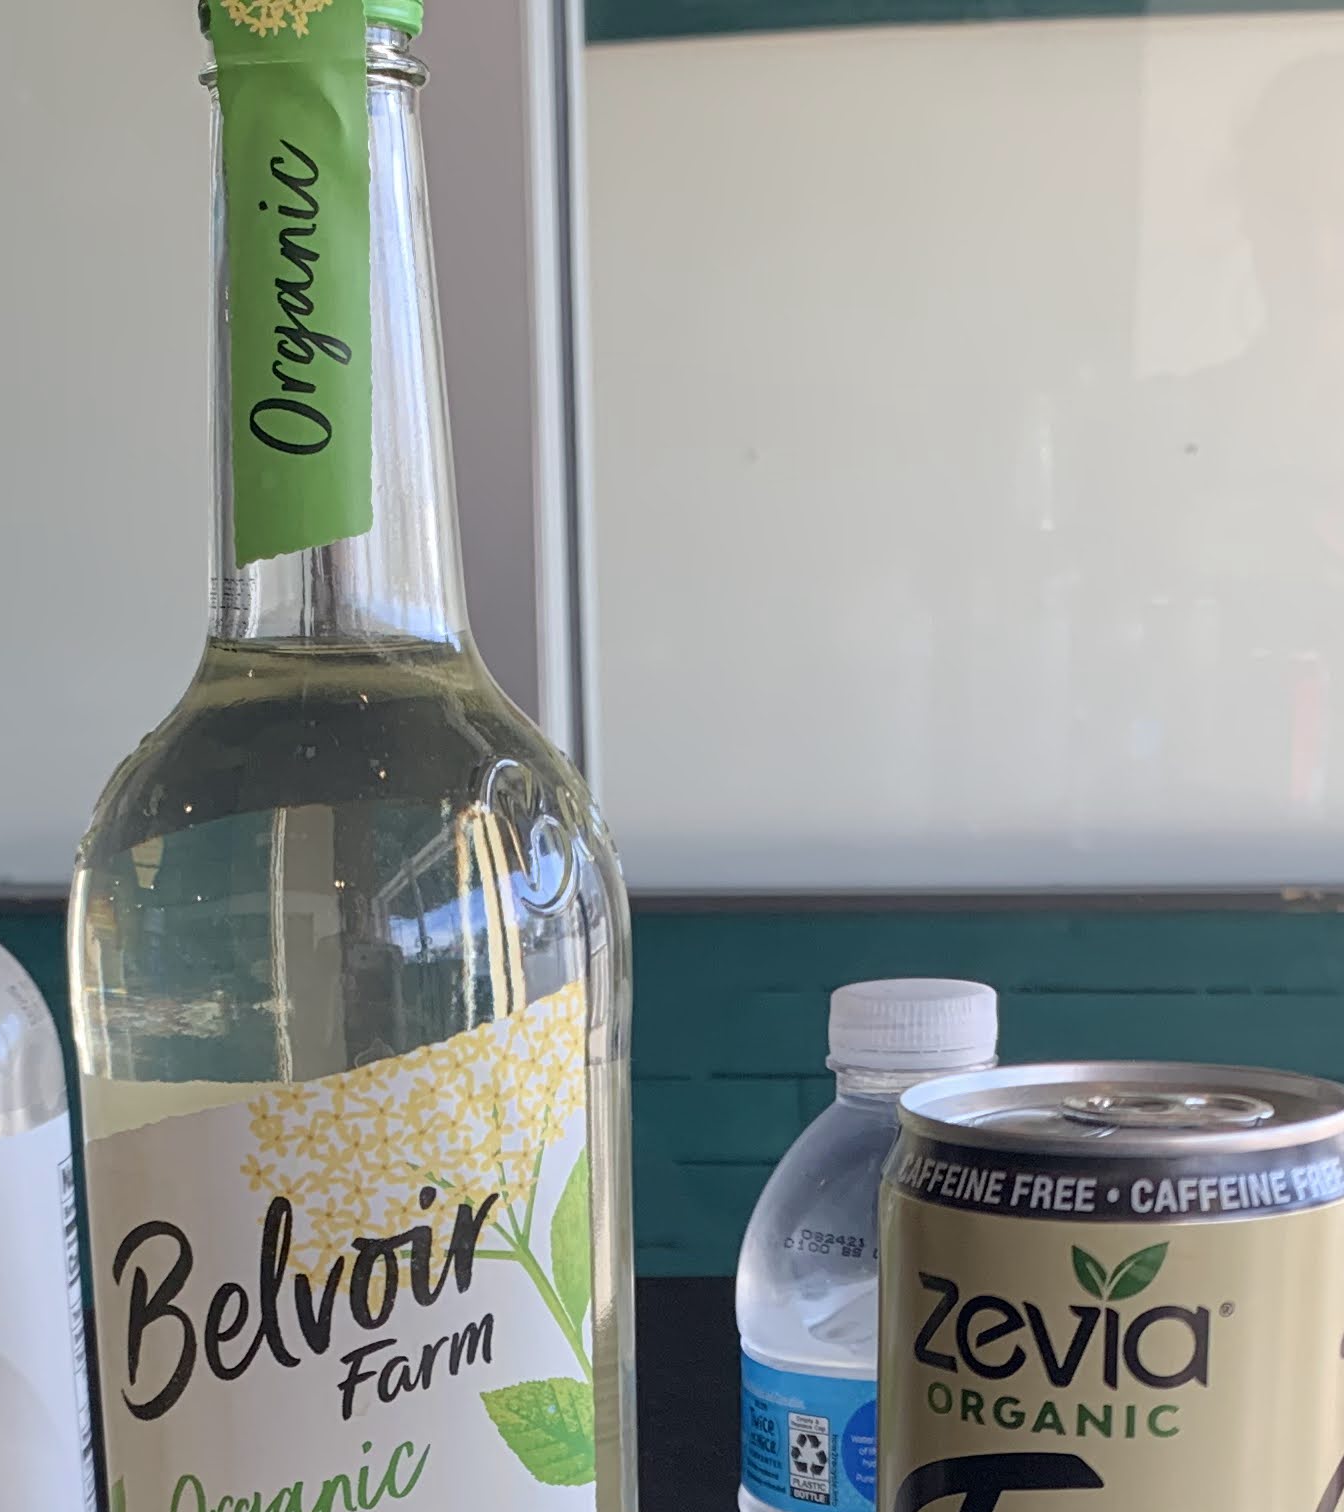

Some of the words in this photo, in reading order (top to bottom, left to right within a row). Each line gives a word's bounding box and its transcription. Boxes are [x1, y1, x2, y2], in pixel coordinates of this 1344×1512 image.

[249, 138, 352, 455] Organic
[897, 1153, 1007, 1204] CAFFEINE
[1009, 1172, 1098, 1212] FREE
[1130, 1168, 1291, 1214] CAFFEINE
[112, 1186, 499, 1421] Belvoir
[336, 1312, 495, 1421] Farm
[926, 1382, 1181, 1439] ORGANIC
[793, 1477, 827, 1492] PLASTIC
[793, 1491, 827, 1504] BOTTLE
